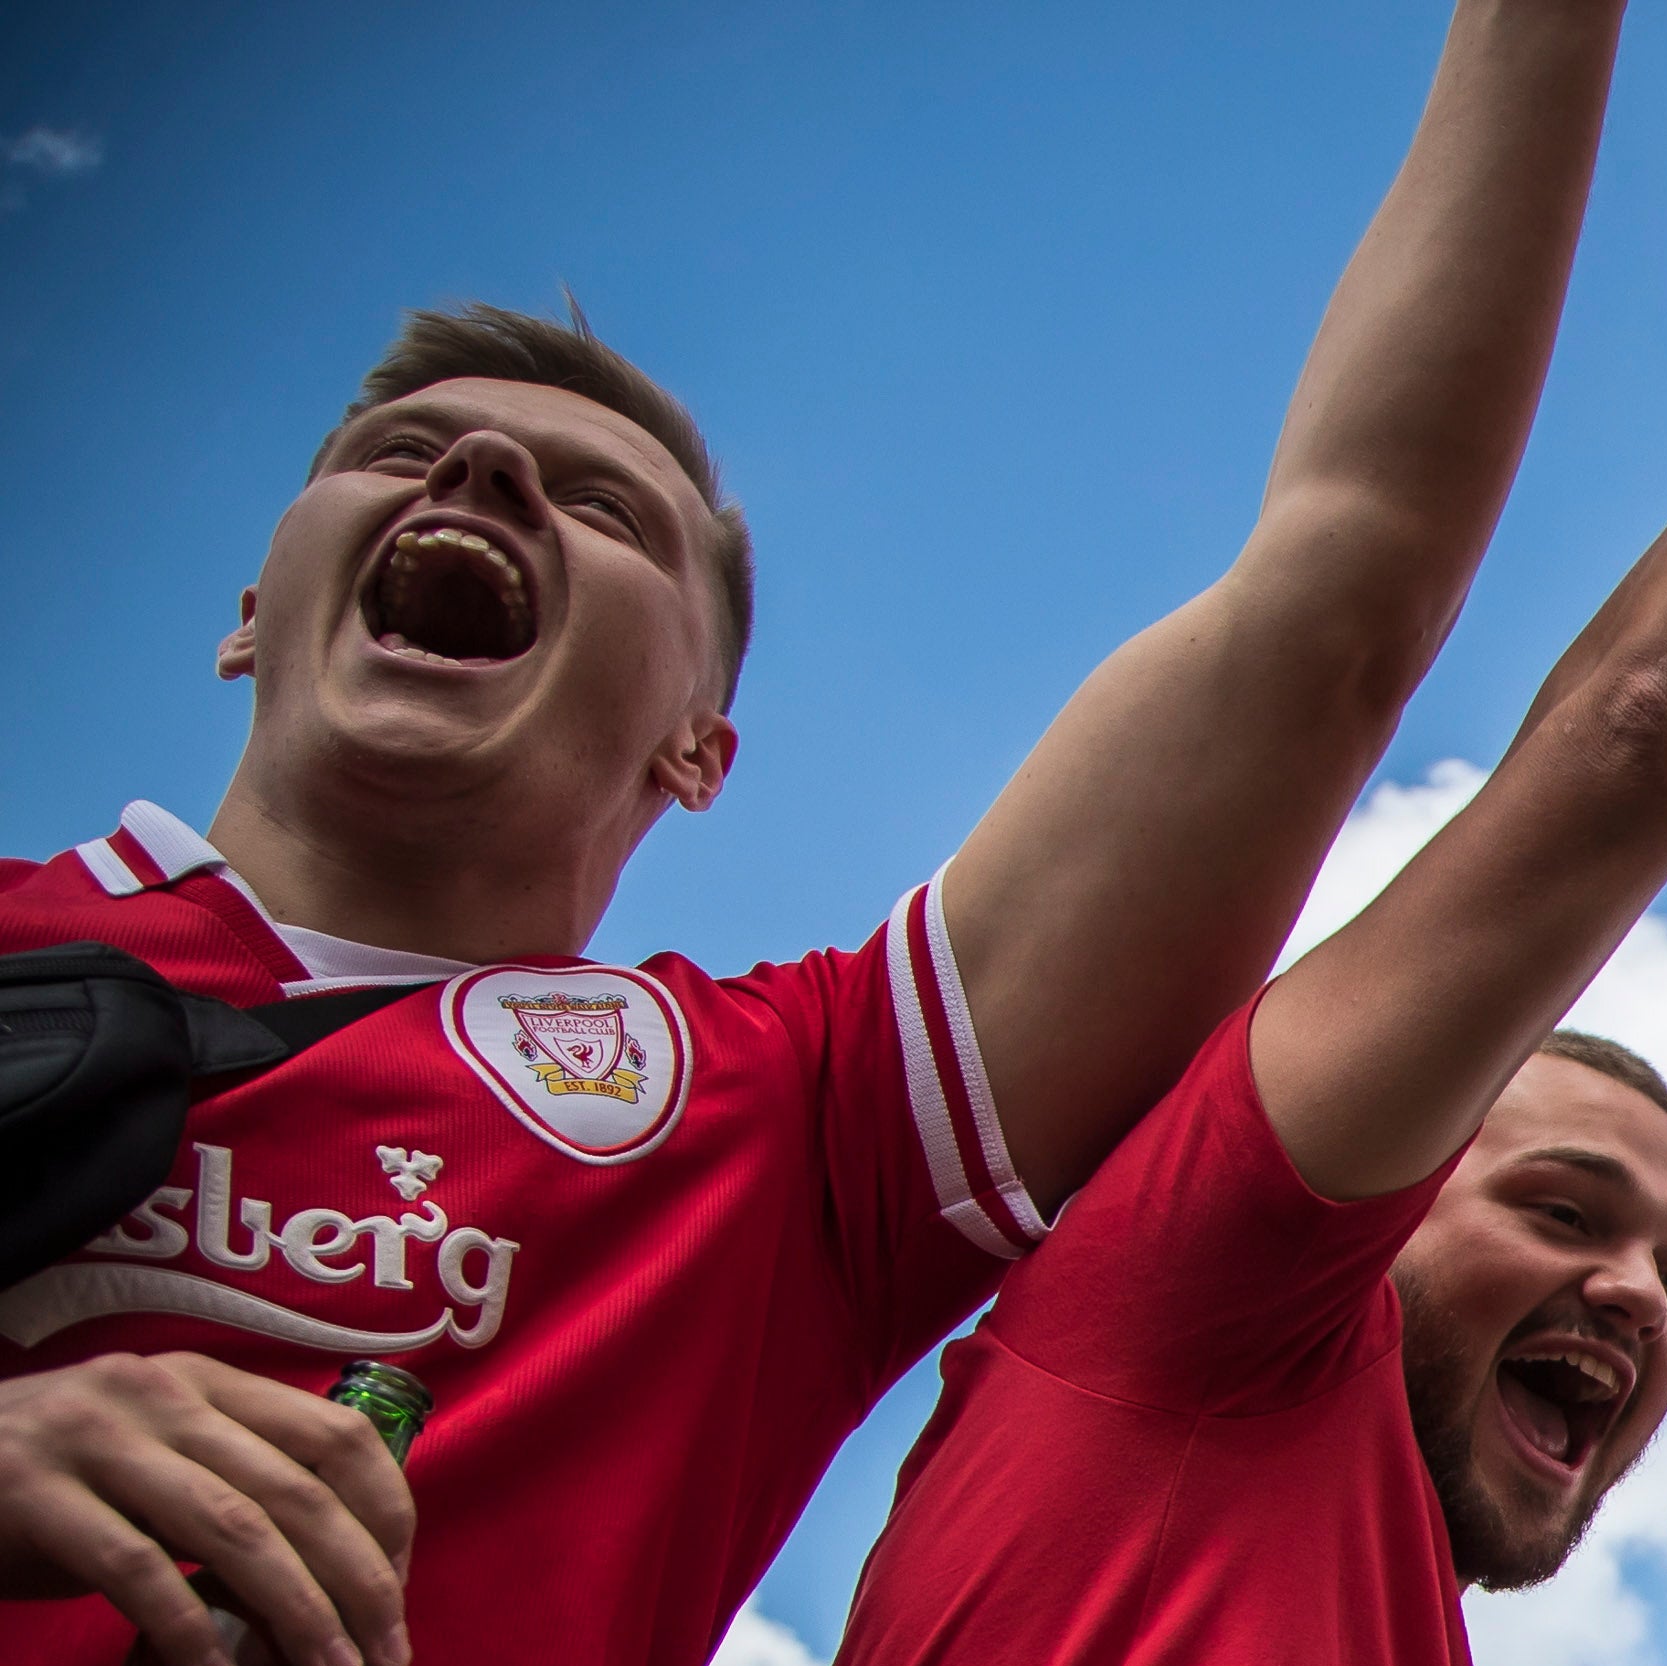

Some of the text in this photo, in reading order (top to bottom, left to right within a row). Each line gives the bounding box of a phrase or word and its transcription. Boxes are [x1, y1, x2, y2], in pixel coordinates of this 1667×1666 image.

[530, 1018, 612, 1028] LIVERPOOL
[533, 1026, 616, 1036] FOOTBALL CLUB
[564, 1081, 622, 1097] EST. 1892
[86, 1142, 521, 1349] sberg
